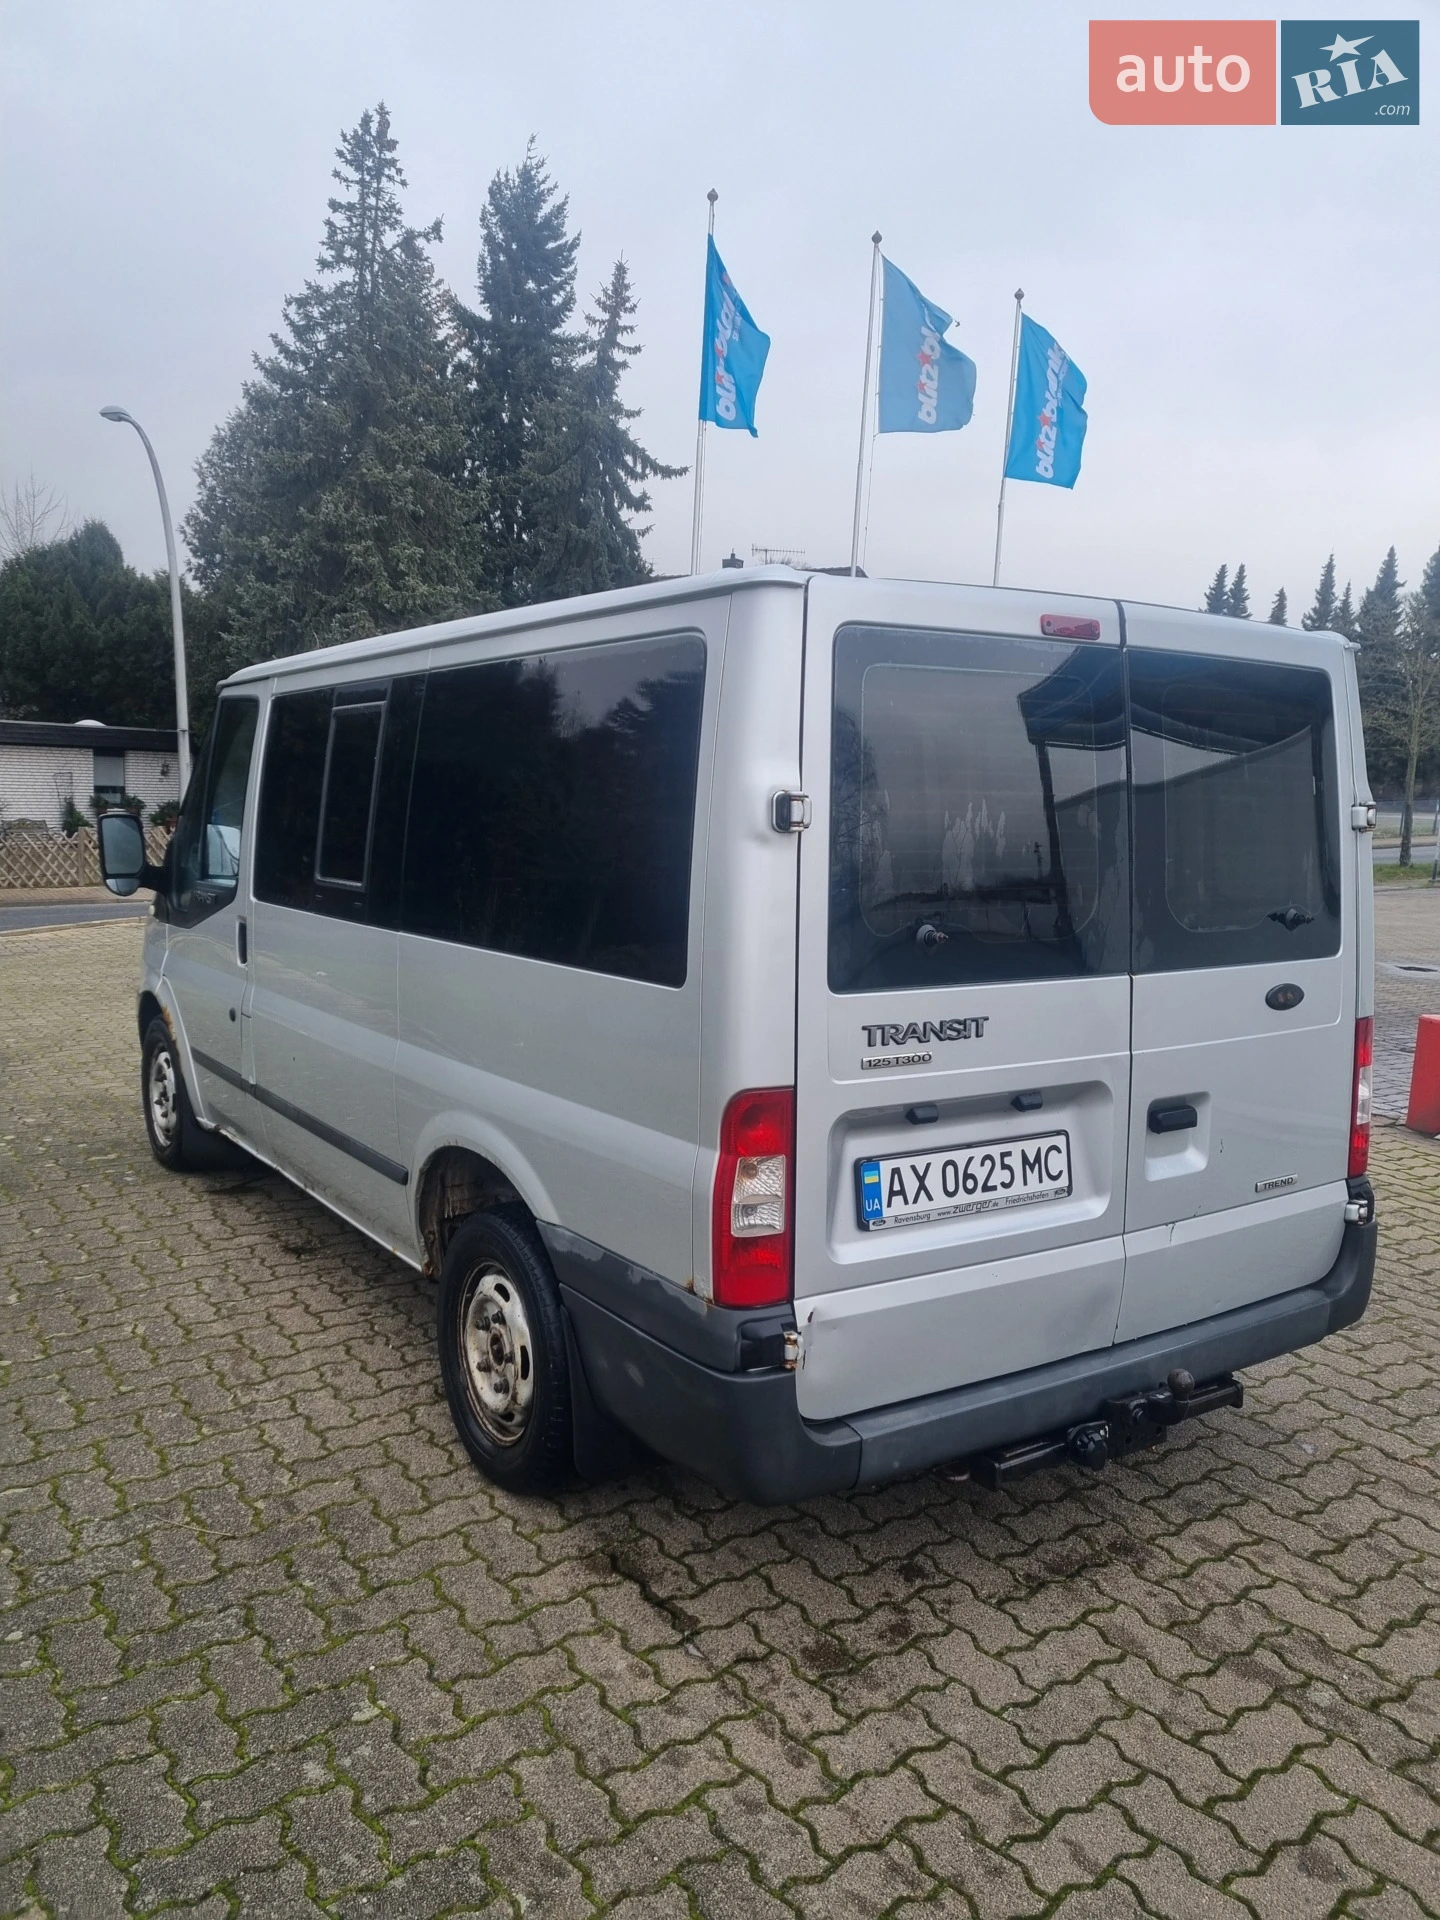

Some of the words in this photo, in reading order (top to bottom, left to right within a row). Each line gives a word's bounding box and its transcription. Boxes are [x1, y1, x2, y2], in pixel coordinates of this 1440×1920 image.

[861, 1016, 990, 1047] TRANSIT
[941, 1151, 1015, 1198] 0625
[1262, 1177, 1294, 1190] TREND
[865, 1198, 881, 1212] UA
